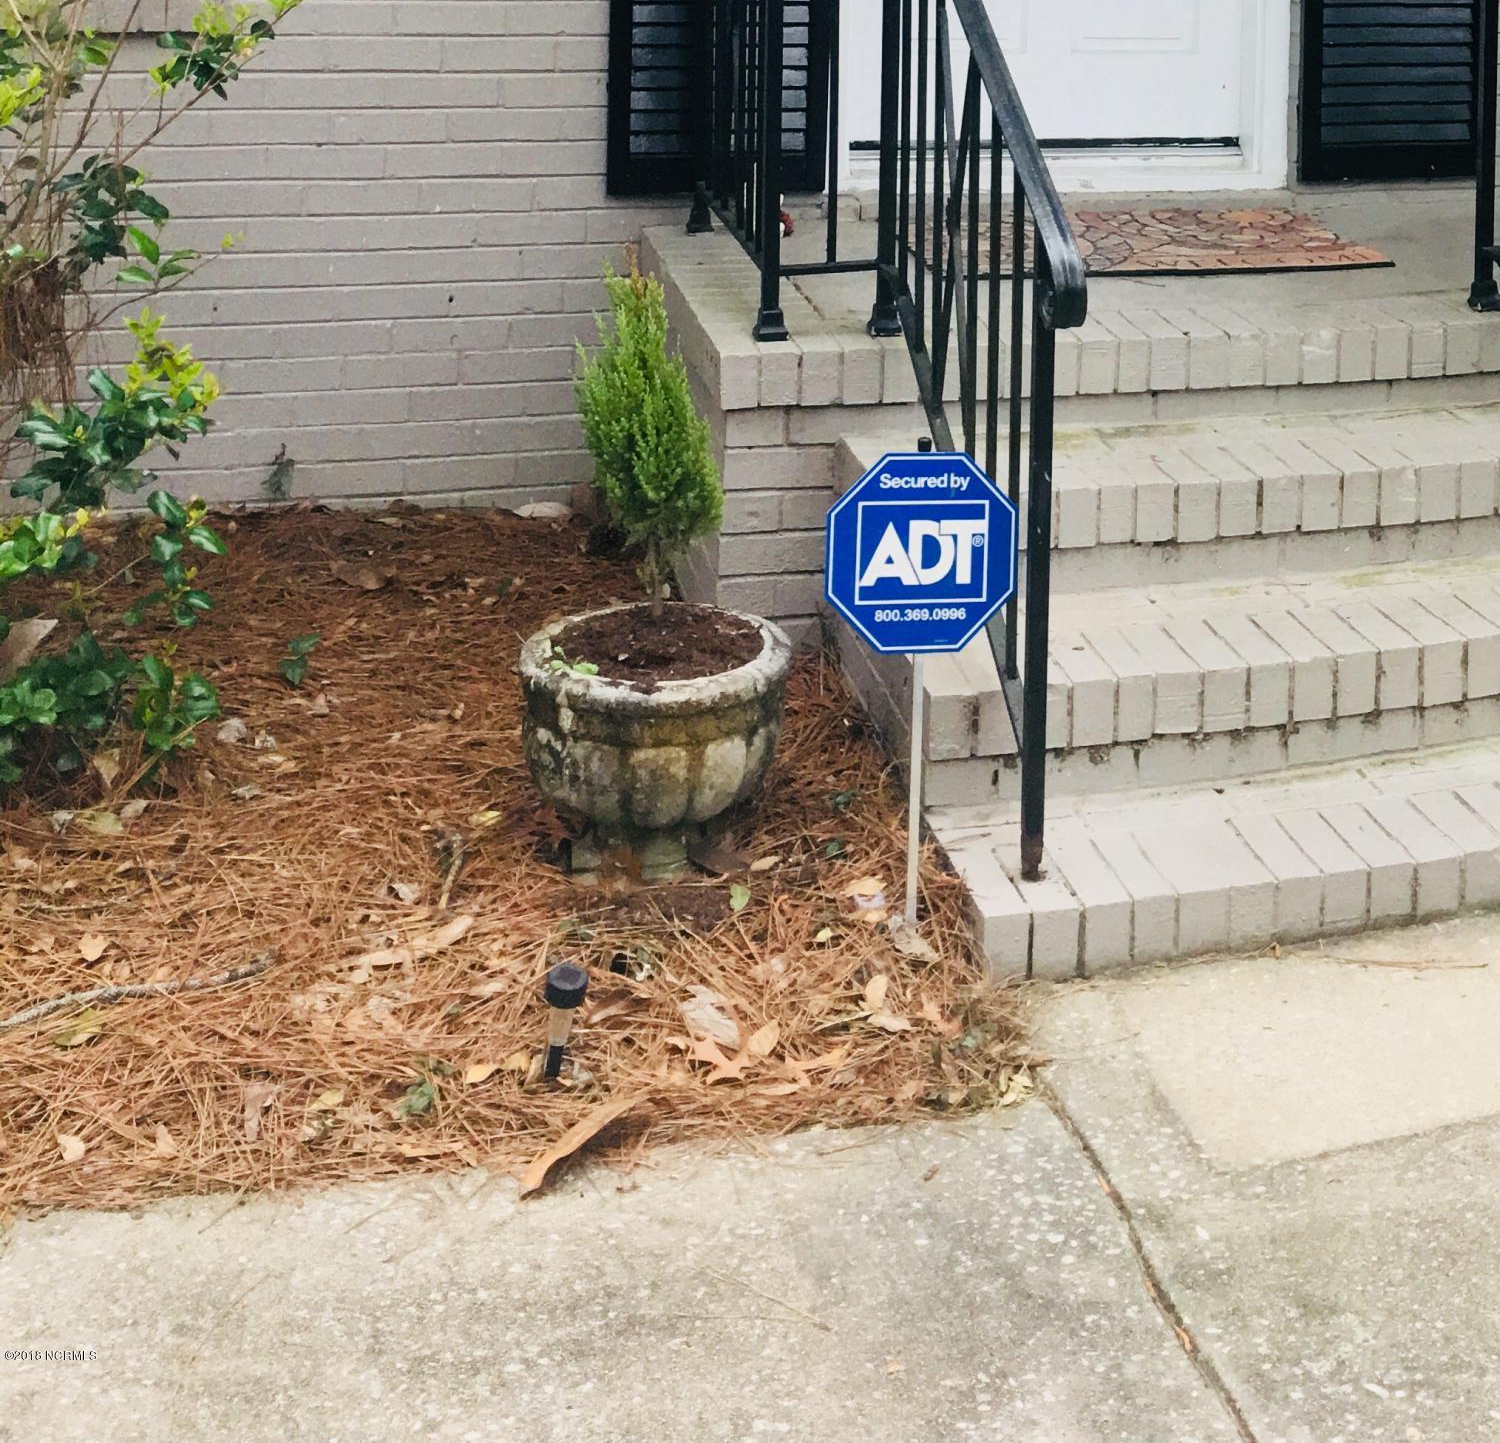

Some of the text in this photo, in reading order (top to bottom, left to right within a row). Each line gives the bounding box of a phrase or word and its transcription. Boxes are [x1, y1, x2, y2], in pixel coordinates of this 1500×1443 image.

[879, 472, 971, 491] Secured by
[874, 607, 967, 623] 800.369.0996
